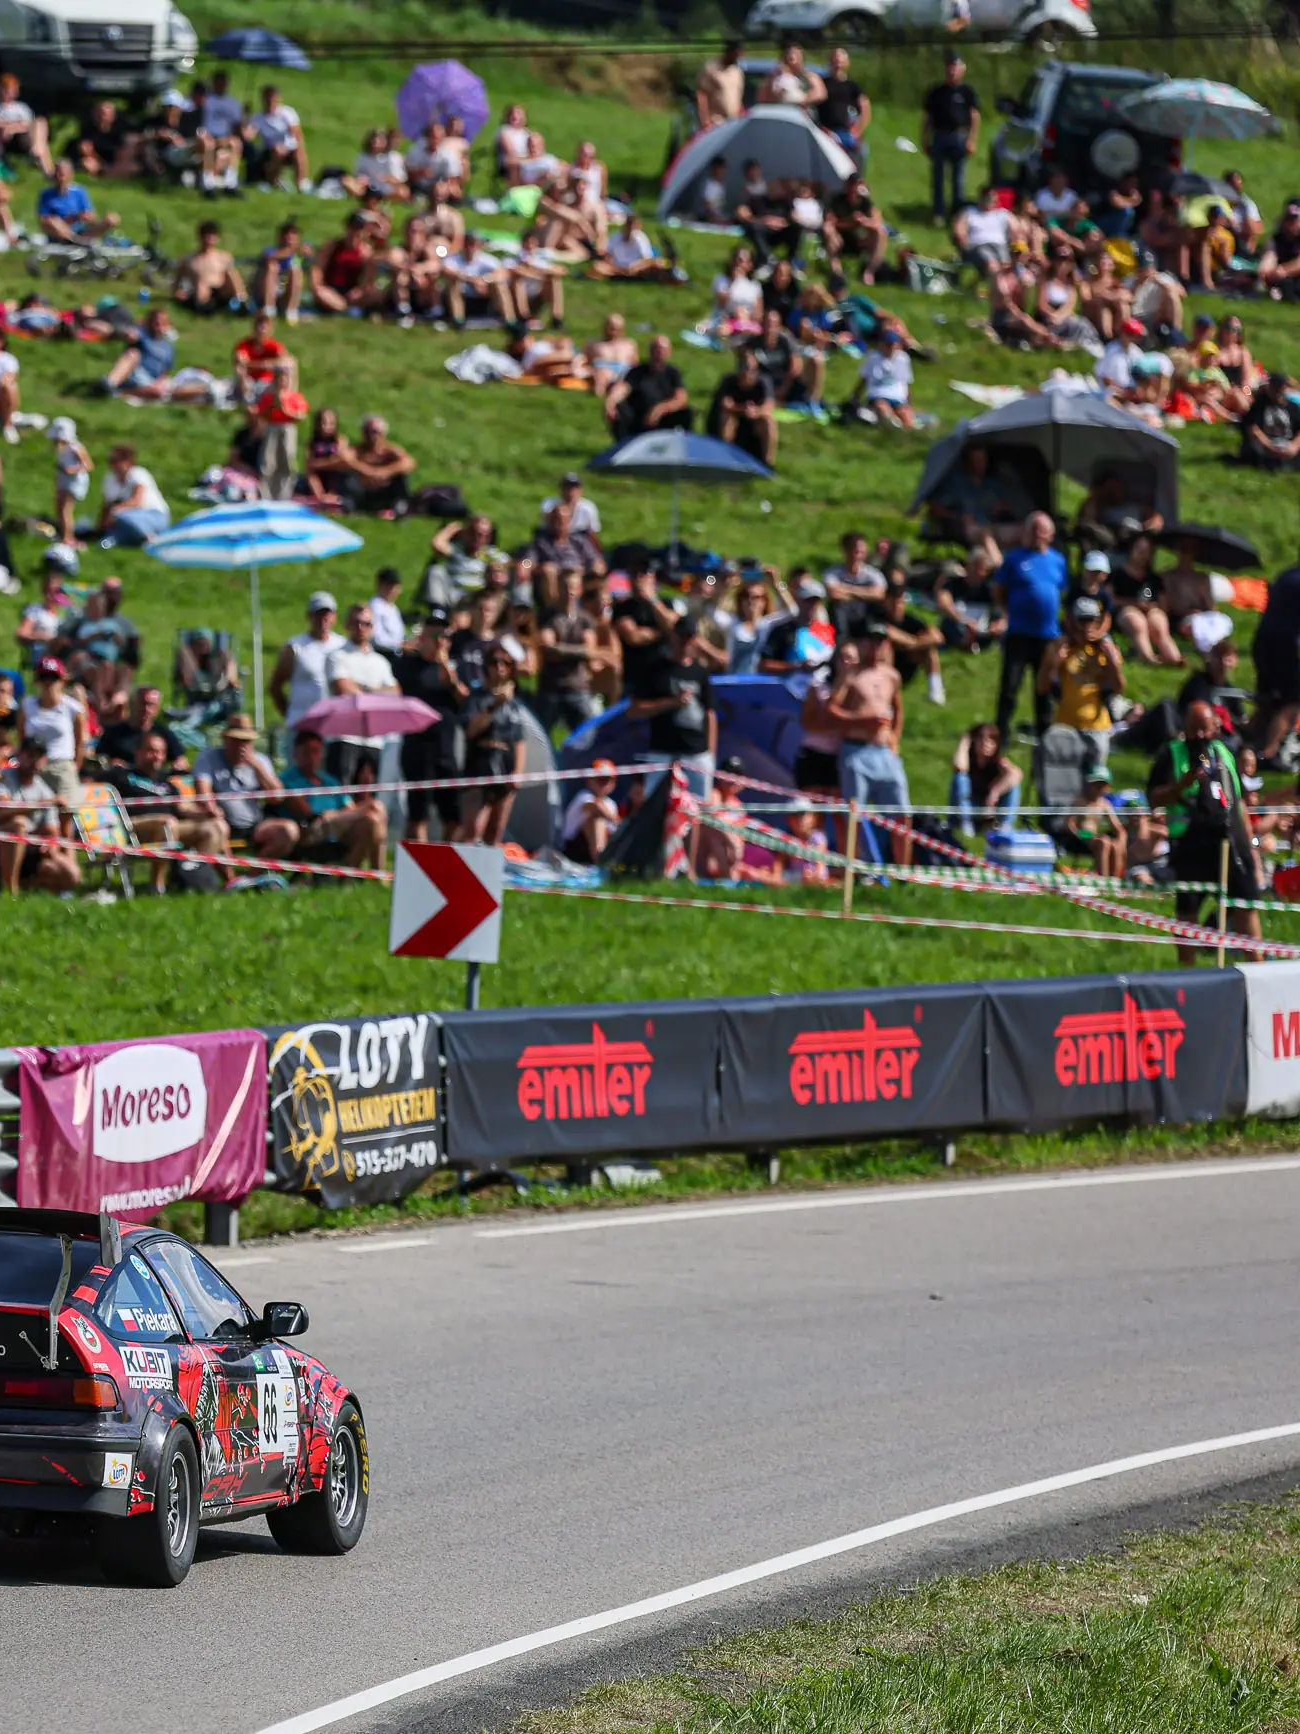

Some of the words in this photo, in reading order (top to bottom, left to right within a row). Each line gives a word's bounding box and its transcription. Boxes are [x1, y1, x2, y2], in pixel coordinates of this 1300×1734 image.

[338, 1014, 429, 1091] LOTY
[787, 1007, 923, 1106] emiter
[1053, 990, 1186, 1087] emiter
[516, 1020, 655, 1121] emiter
[102, 1083, 191, 1131] Moreso
[132, 1307, 178, 1332] Piekara
[124, 1350, 167, 1375] KUBIT
[129, 1377, 174, 1391] MOTORSPORT
[263, 1382, 278, 1444] 66
